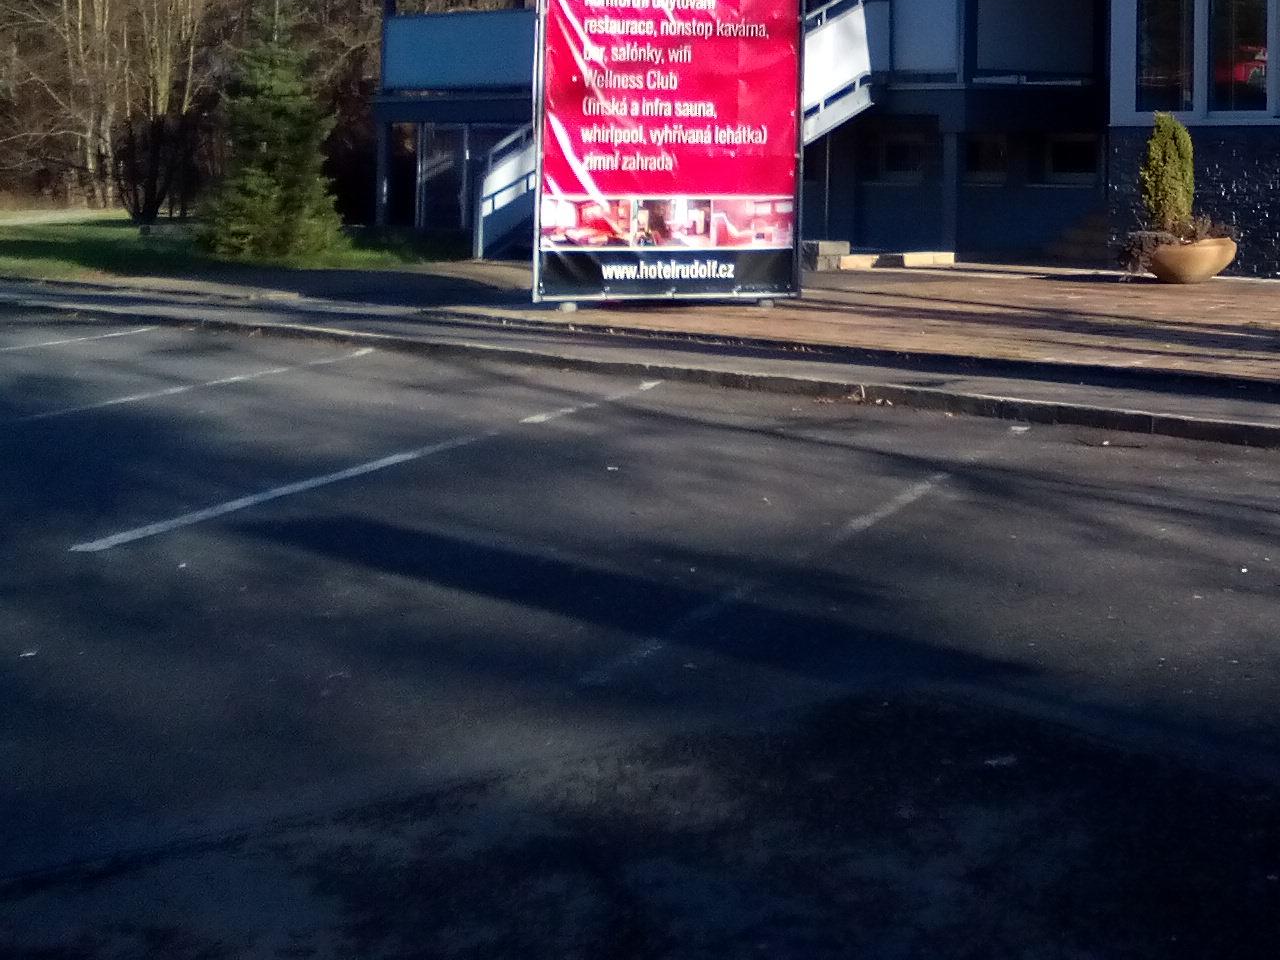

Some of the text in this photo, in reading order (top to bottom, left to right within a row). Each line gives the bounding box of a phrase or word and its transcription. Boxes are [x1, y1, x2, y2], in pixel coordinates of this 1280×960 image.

[584, 16, 769, 39] restaurace, nonstop kavárna,
[611, 43, 665, 64] salónky,
[668, 45, 692, 63] wifi
[585, 70, 678, 90] Wellness Club
[631, 103, 639, 116] a
[642, 98, 672, 116] infra
[674, 101, 718, 119] sauna,
[715, 125, 768, 144] lehátka)
[601, 259, 735, 280] www.hotelrudolf.cz
